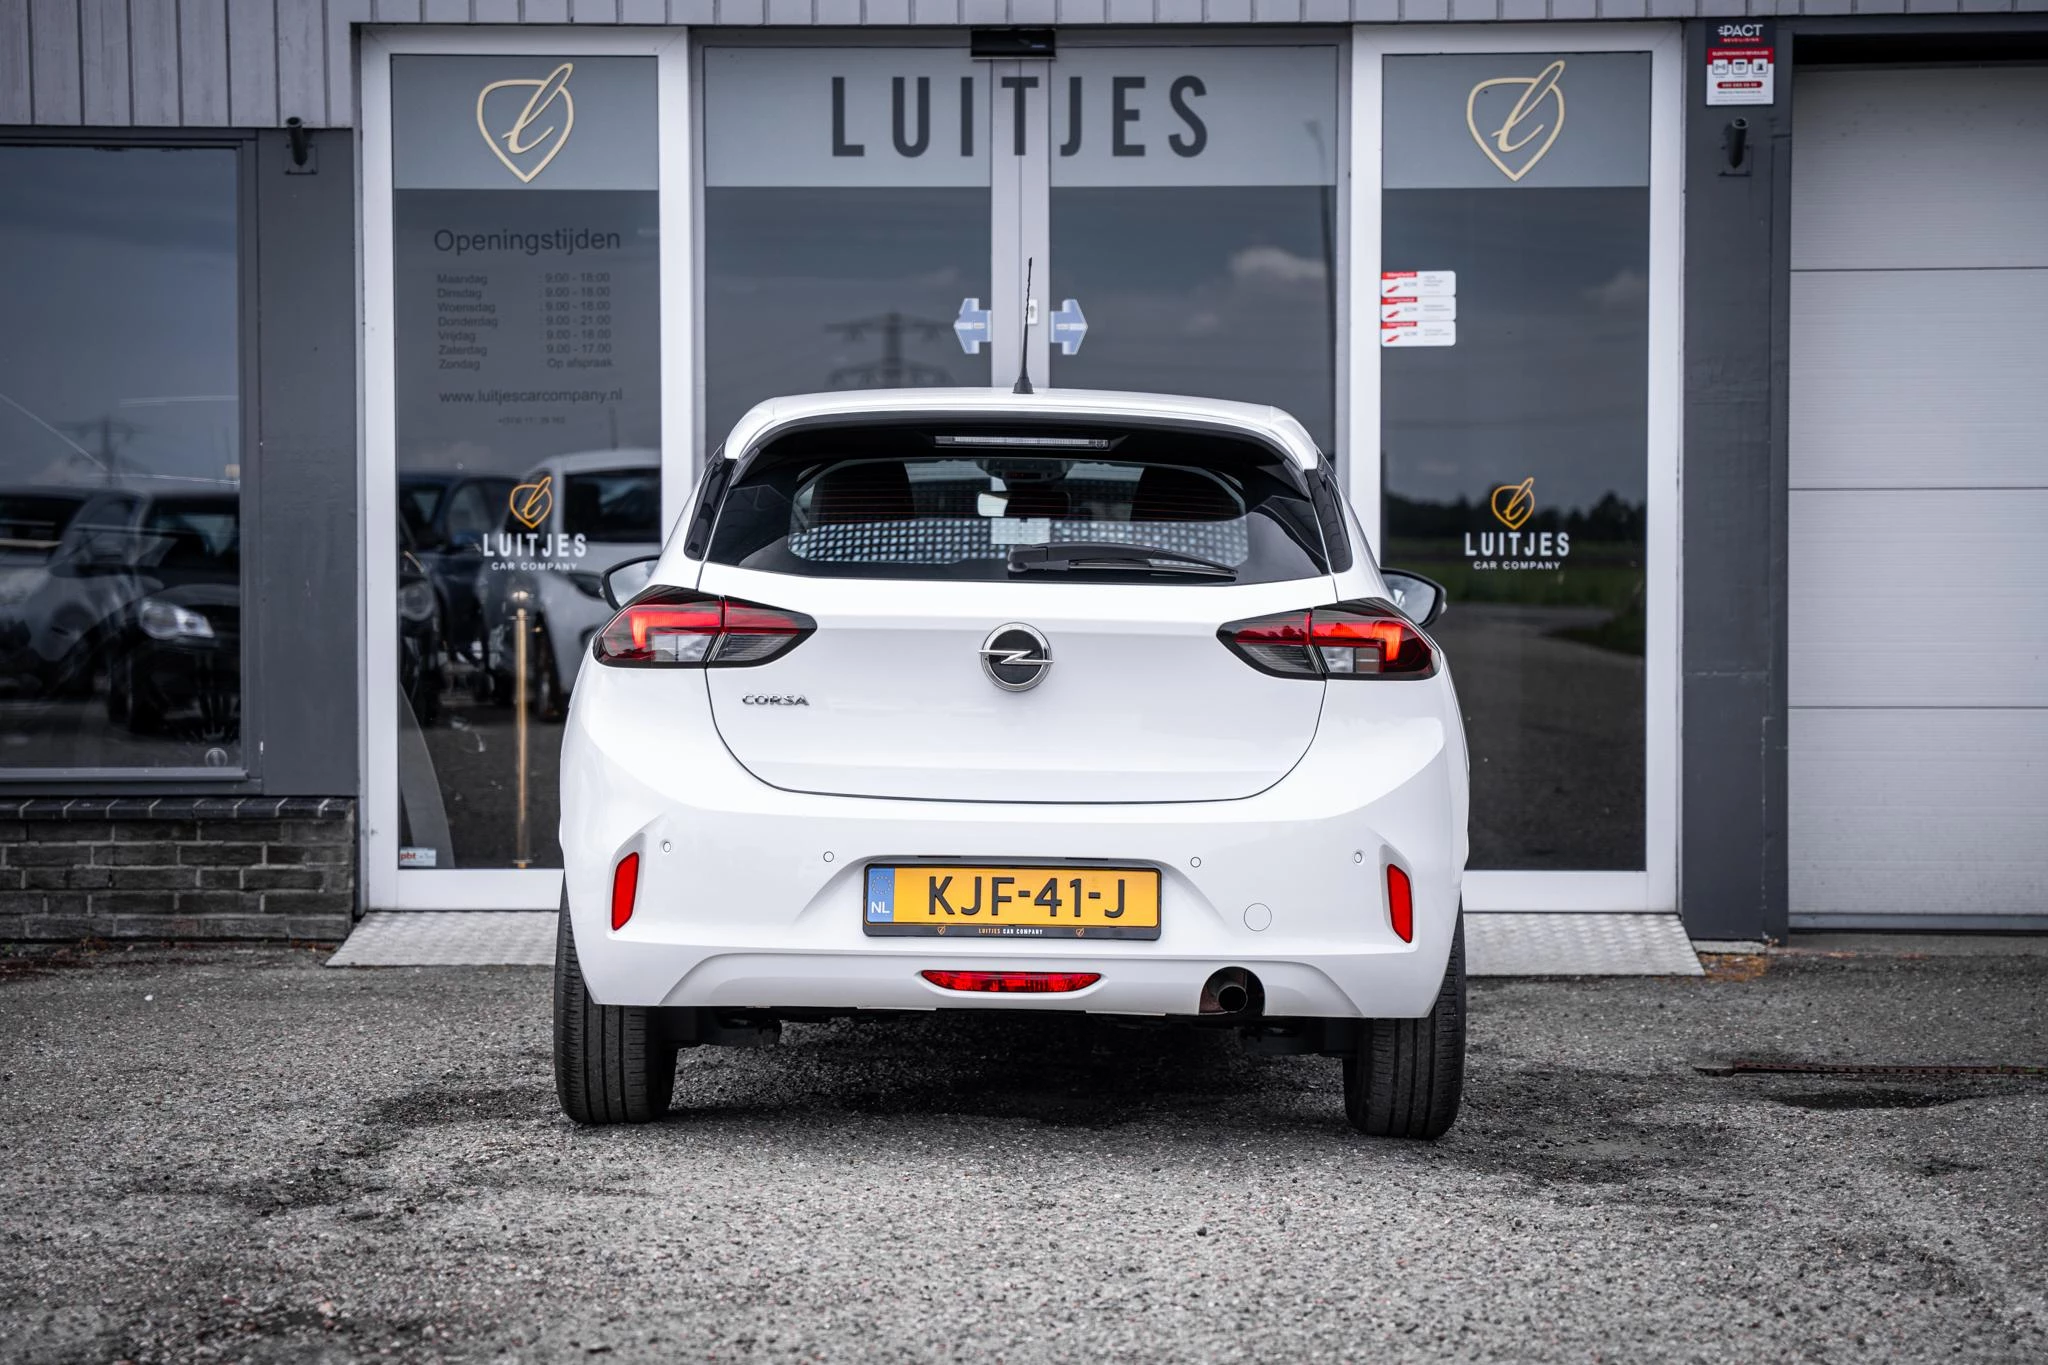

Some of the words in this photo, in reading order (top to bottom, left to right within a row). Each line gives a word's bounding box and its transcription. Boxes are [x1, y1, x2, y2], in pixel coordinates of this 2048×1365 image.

[1719, 24, 1763, 37] PACT
[831, 75, 1208, 157] LUITJES
[434, 228, 621, 256] Openingstijden
[436, 274, 488, 286] Maandag
[437, 288, 482, 300] Dinsdag
[437, 302, 496, 314] Woensdag
[438, 316, 498, 329] Donderdag
[438, 331, 476, 343] Vrijdag
[438, 344, 488, 357] Zaterdag
[439, 359, 480, 371] Zondag
[546, 358, 564, 370] Op
[566, 358, 614, 369] afspraak
[439, 387, 623, 406] www.luitjescarcompany.nl
[483, 533, 586, 557] LUITJES
[1465, 532, 1570, 557] LUITJES
[491, 562, 515, 571] CAR
[520, 562, 578, 571] COMPANY
[1473, 561, 1498, 570] CAR
[1502, 561, 1561, 570] COMPANY
[742, 694, 810, 706] CORSA
[928, 875, 1125, 919] KJF-41-J
[871, 901, 890, 914] NL
[1016, 928, 1043, 936] COMPANY
